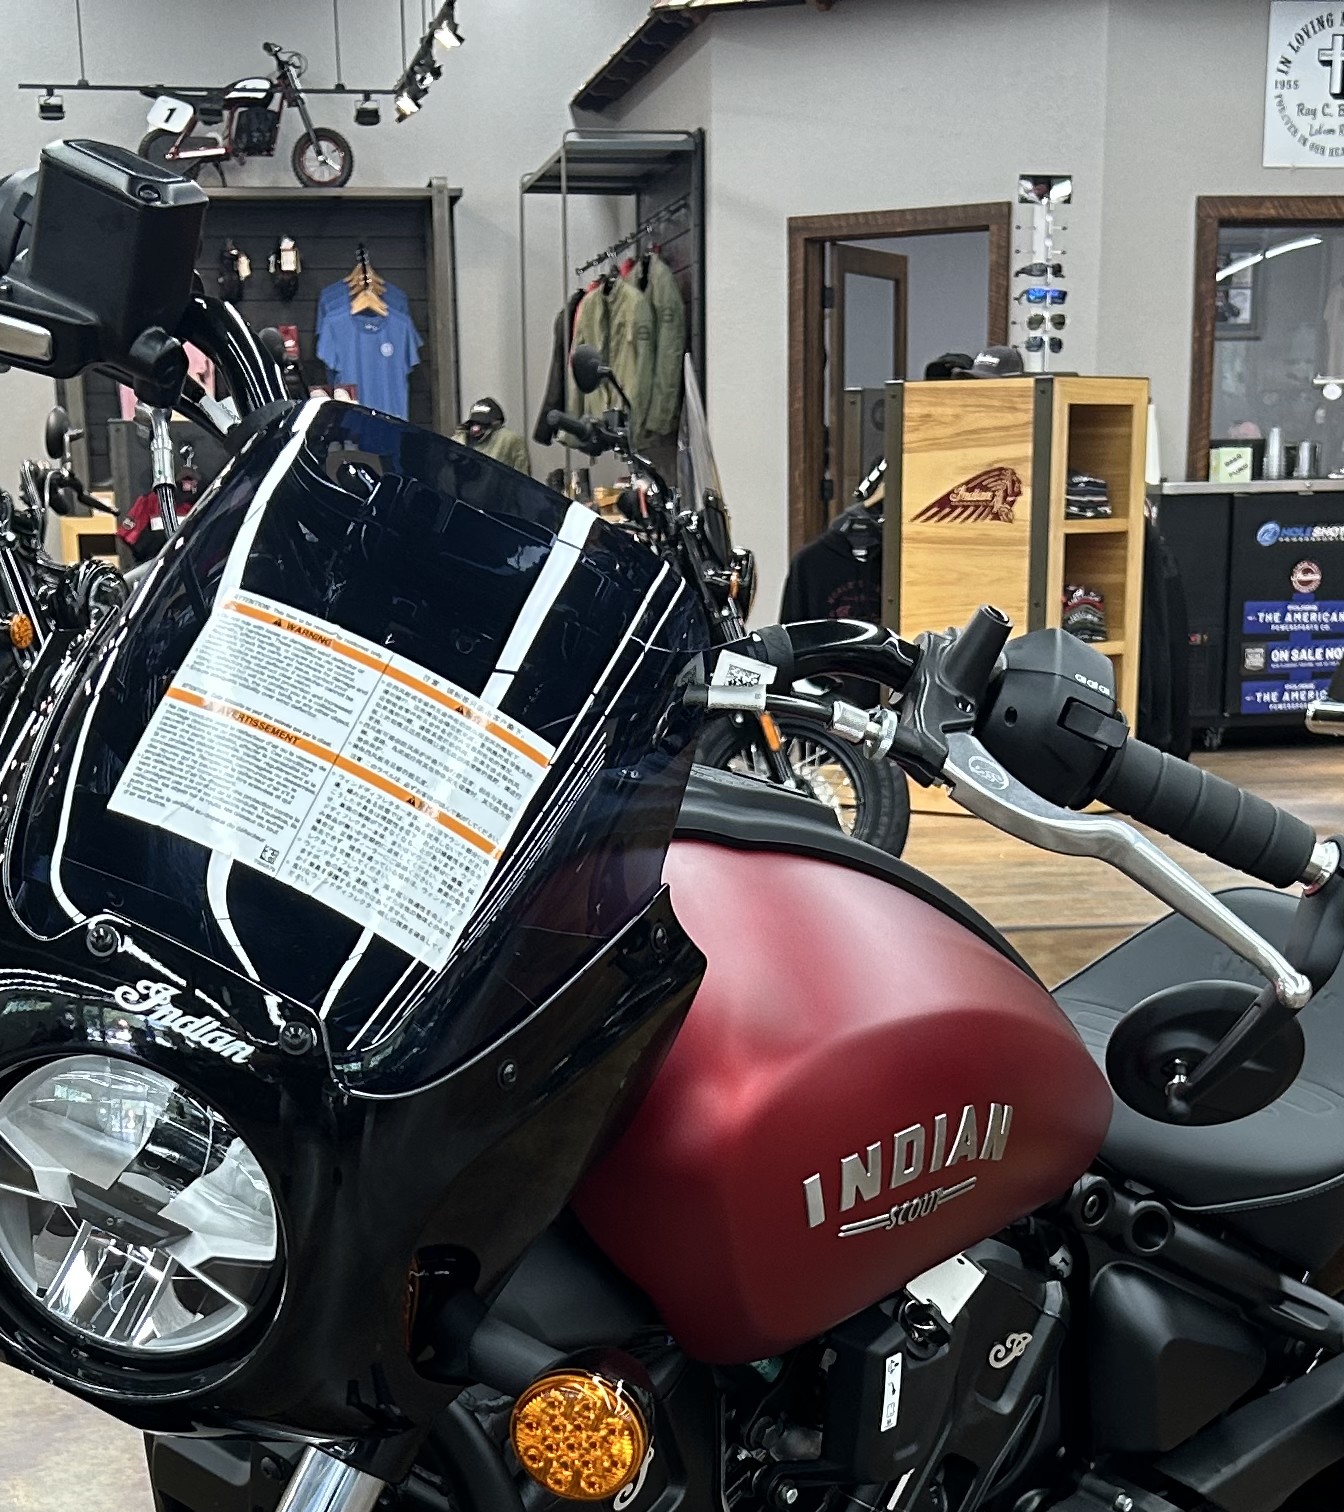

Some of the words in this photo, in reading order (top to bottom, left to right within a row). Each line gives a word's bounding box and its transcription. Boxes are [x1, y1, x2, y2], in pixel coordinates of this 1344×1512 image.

[1276, 55, 1293, 76] IN
[1287, 12, 1334, 54] LOVING
[164, 107, 177, 123] 1
[1258, 612, 1281, 623] THE
[286, 623, 333, 647] WARNING
[1271, 649, 1289, 662] ON
[1290, 648, 1324, 661] SALE
[1255, 692, 1279, 703] THE
[1282, 689, 1328, 702] AMERIC
[115, 979, 256, 1063] Indian
[803, 1102, 1013, 1228] INDIAN
[885, 1187, 945, 1231] SCOUT
